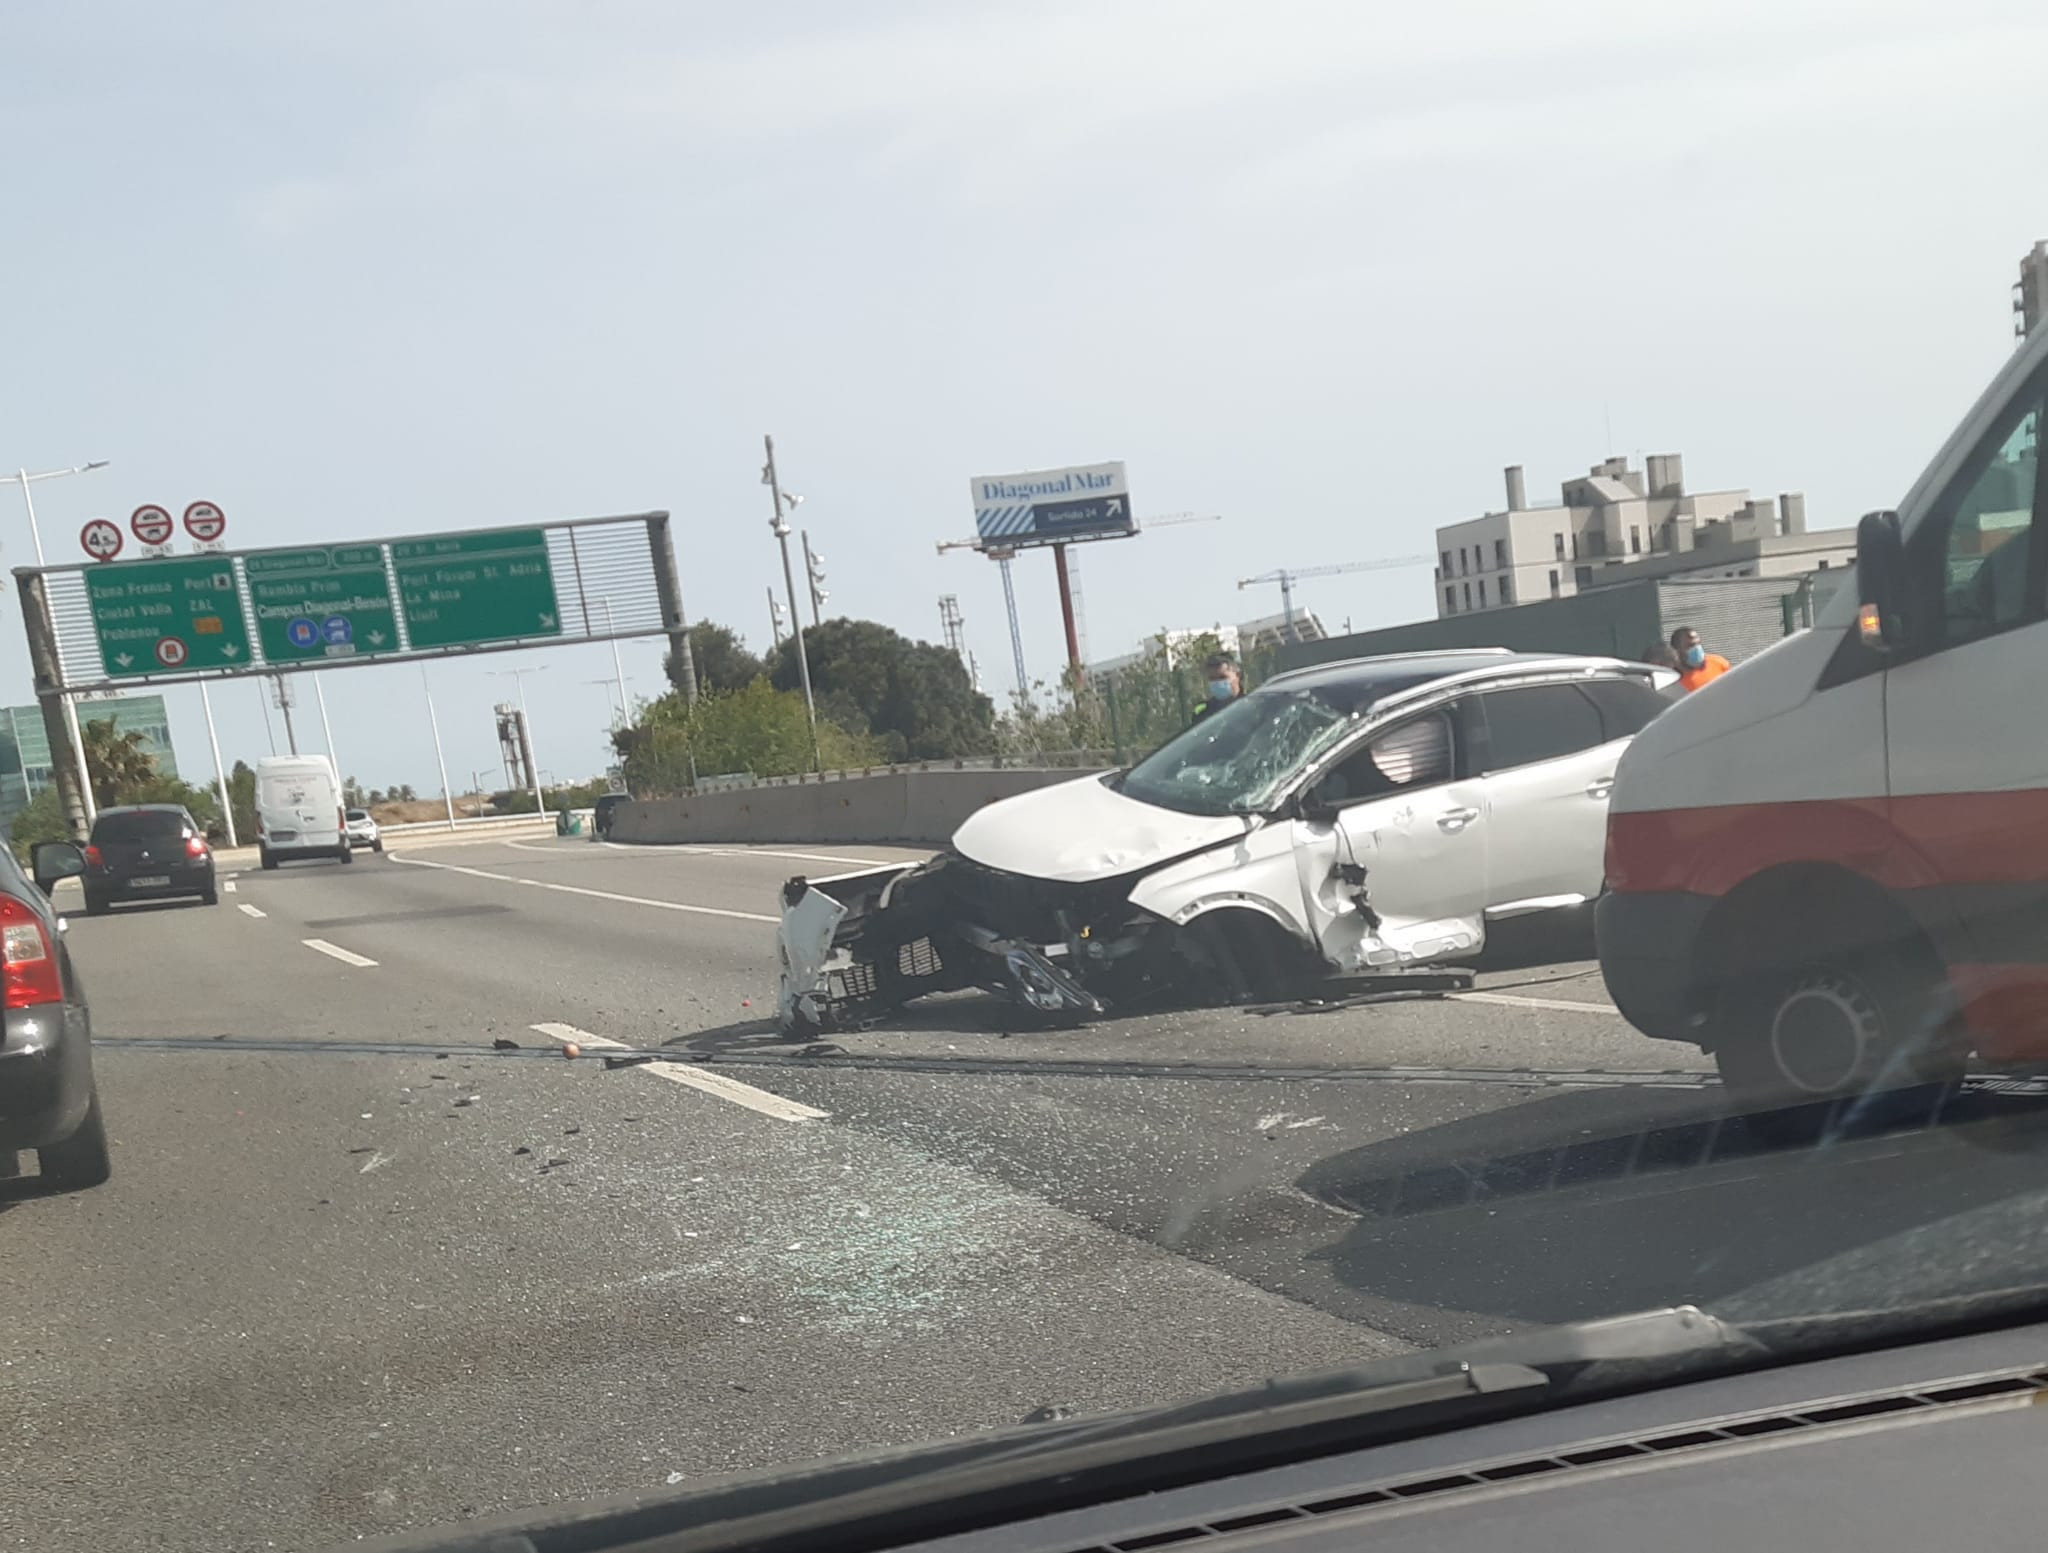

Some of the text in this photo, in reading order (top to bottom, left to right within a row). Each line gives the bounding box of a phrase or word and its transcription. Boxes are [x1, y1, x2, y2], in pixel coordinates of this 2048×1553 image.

[983, 472, 1113, 500] Diagonal Mar
[257, 603, 304, 618] Campus
